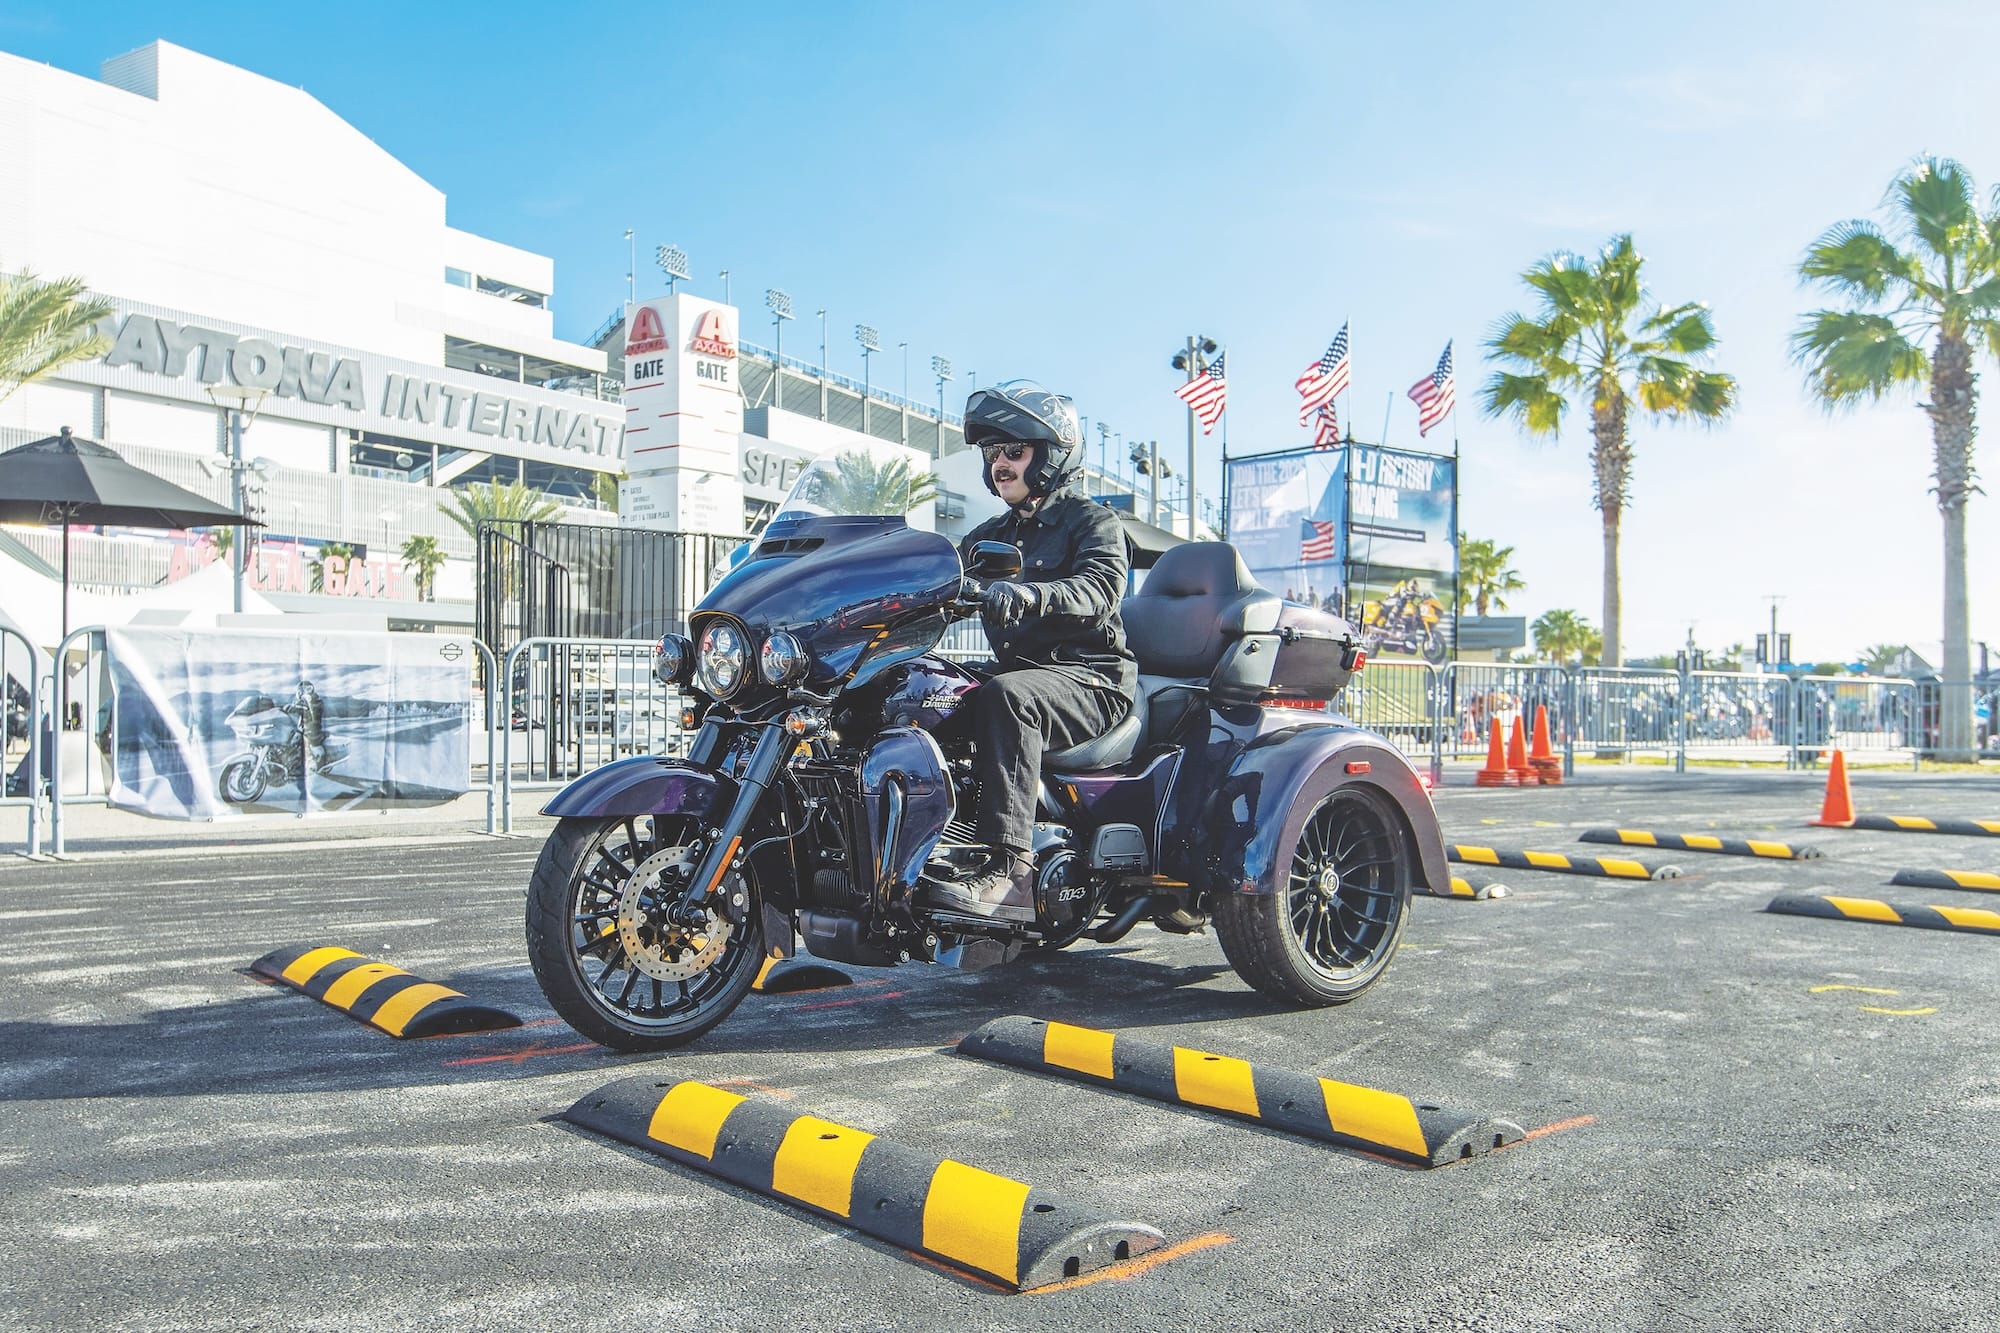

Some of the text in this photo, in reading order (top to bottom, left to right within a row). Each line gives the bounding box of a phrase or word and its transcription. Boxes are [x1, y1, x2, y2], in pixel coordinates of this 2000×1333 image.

[625, 339, 669, 356] AXALTA
[691, 340, 737, 359] AXALTA
[634, 359, 664, 380] GATE
[696, 361, 728, 383] GATE
[323, 555, 402, 599] GATE
[1058, 886, 1086, 902] 114
